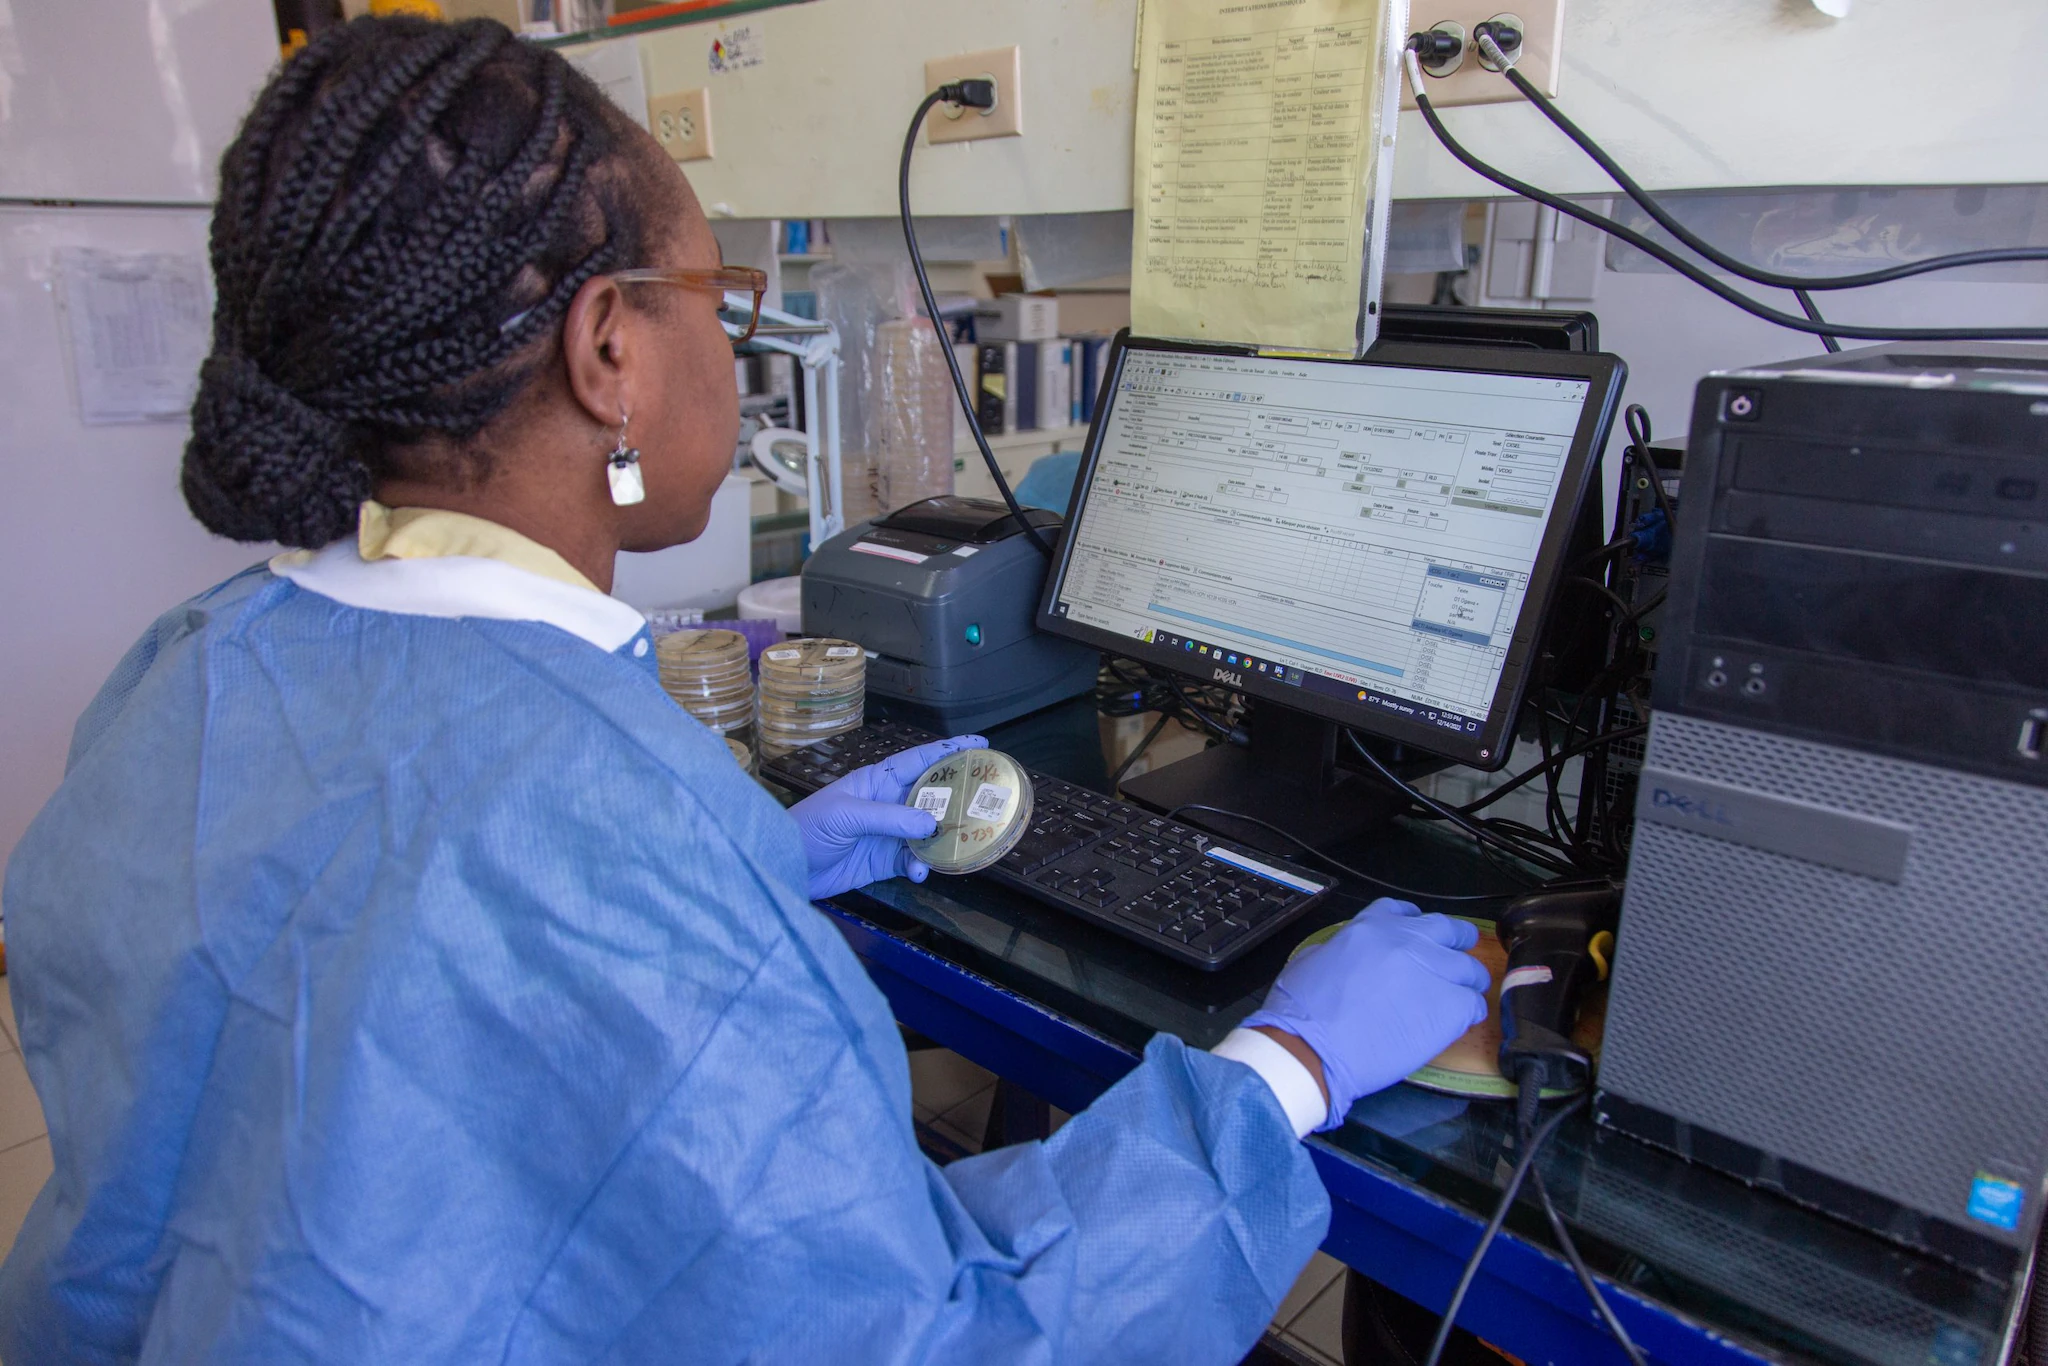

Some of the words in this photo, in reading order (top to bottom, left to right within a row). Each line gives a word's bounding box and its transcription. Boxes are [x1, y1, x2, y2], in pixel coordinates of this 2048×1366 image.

[1212, 667, 1242, 687] DELL
[1382, 700, 1398, 710] Mostly
[1399, 705, 1415, 714] sunny
[1443, 701, 1467, 714] 14/12/2022
[1437, 719, 1462, 731] 12/14/2022
[1652, 788, 1736, 828] DELL
